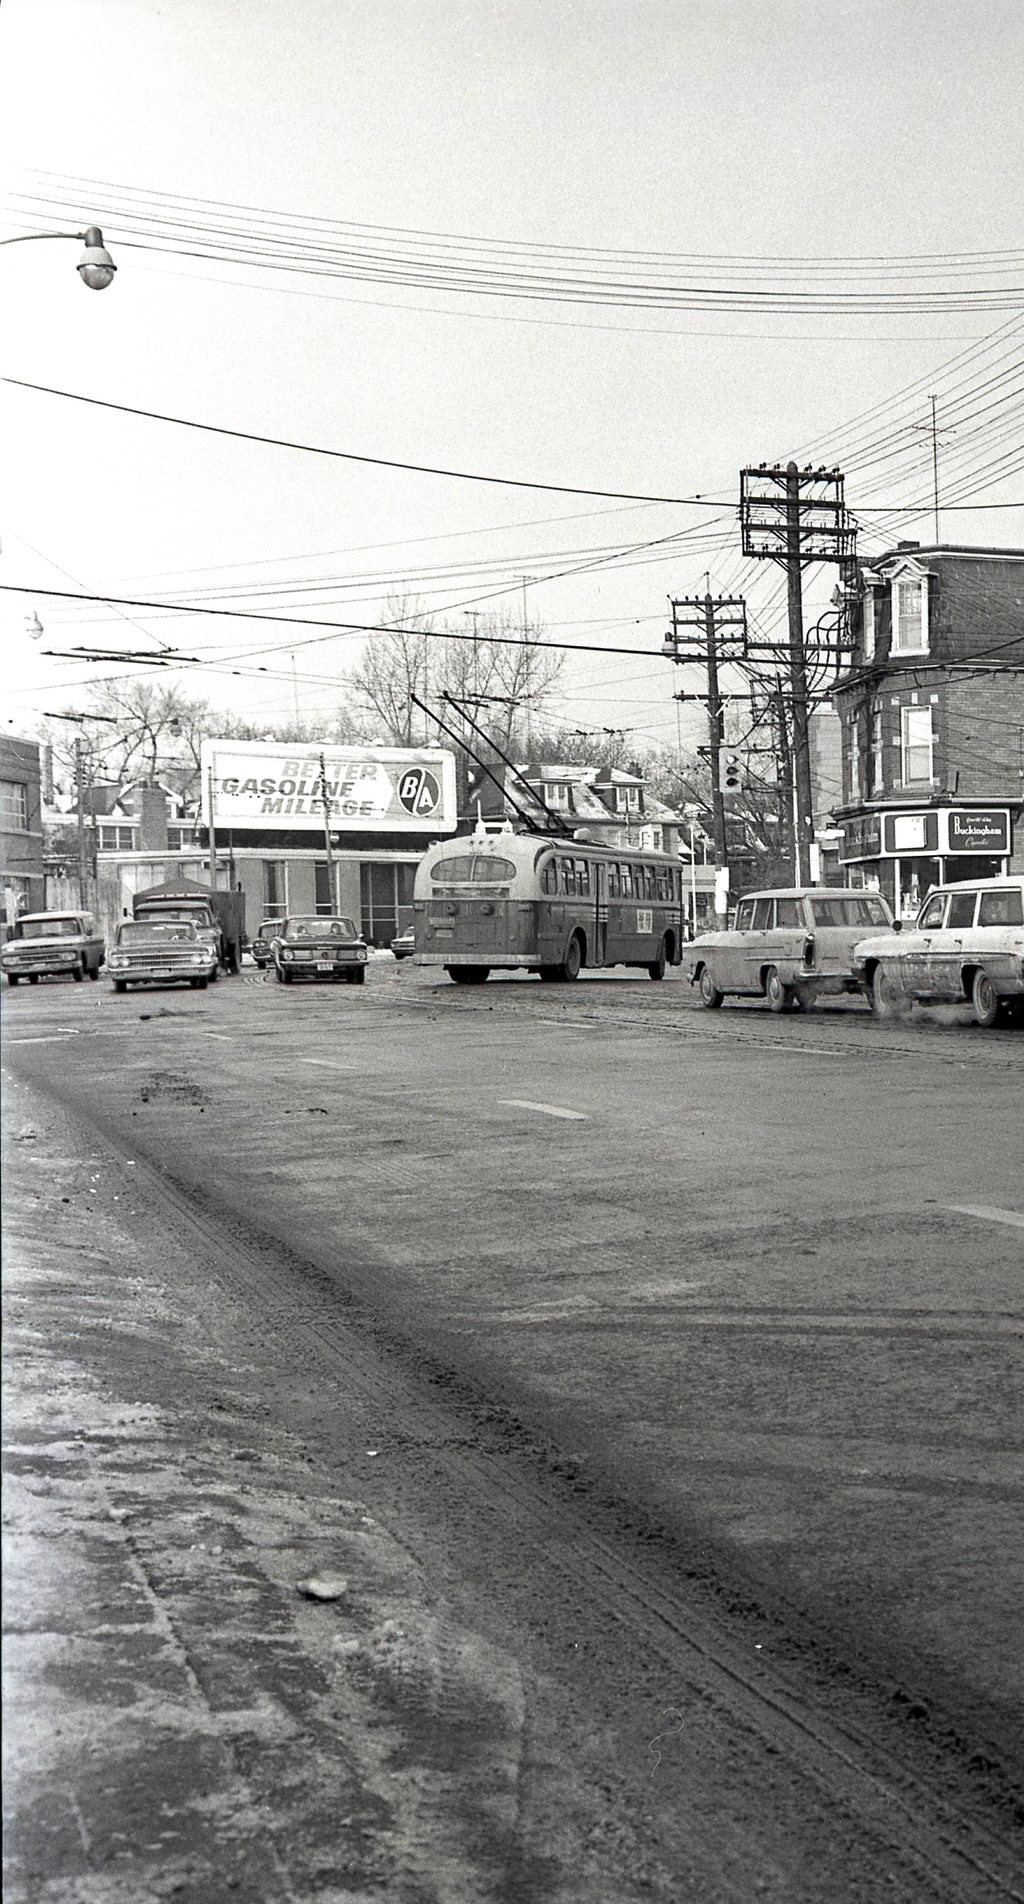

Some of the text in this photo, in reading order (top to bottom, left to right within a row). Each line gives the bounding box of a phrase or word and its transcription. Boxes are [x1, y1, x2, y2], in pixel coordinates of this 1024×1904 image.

[221, 778, 355, 797] GASOLINE
[260, 797, 375, 817] MILEAGE
[954, 816, 1002, 836] Buckingham
